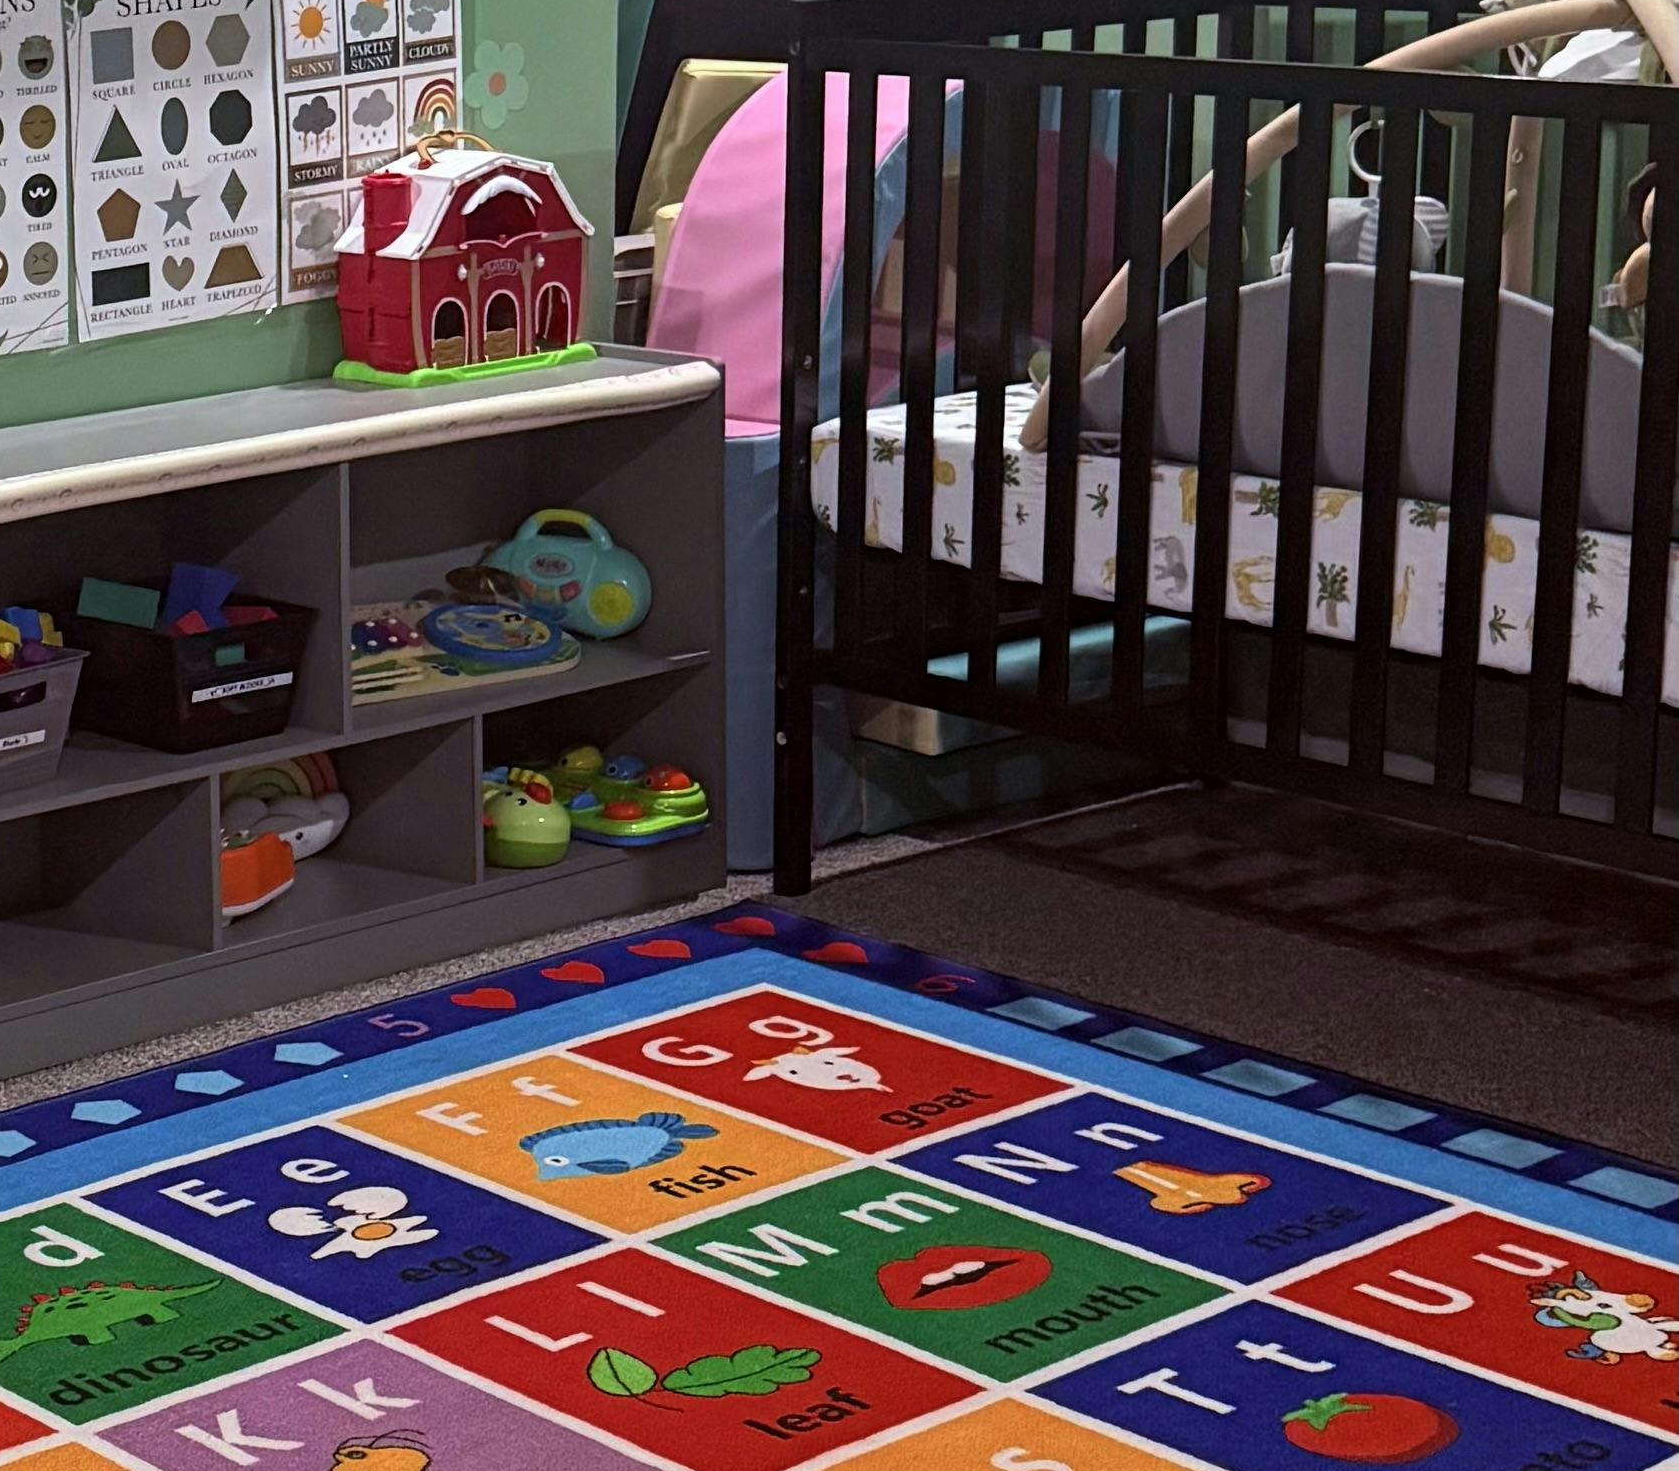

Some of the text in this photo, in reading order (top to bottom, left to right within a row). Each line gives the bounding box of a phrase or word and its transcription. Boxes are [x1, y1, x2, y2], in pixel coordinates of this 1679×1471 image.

[349, 39, 395, 57] PARTLY
[408, 43, 451, 60] CLOUDY
[290, 60, 334, 78] SUNNY
[350, 54, 393, 72] SUNNY
[153, 77, 192, 92] CIRCLE
[203, 69, 255, 86] HEXAGON
[92, 85, 137, 102] SQUARE
[25, 153, 51, 164] CALM
[162, 158, 190, 172] OVAL
[207, 148, 258, 165] OCTAGON
[91, 165, 145, 182] TRIANGLE
[294, 165, 339, 182] STORMY
[163, 236, 191, 249] STAR
[209, 225, 259, 243] DIAMOND
[91, 243, 149, 261] PENTAGON
[161, 296, 197, 312] HEART
[90, 304, 154, 324] RECTANGLE
[368, 1014, 430, 1041] 5
[877, 1082, 999, 1132] goat
[647, 1159, 760, 1206] fish
[1246, 1201, 1369, 1256] nose
[397, 1237, 514, 1288] egg
[984, 1277, 1164, 1358] mouth
[44, 1307, 303, 1414] dinosaur
[741, 1386, 874, 1445] leaf
